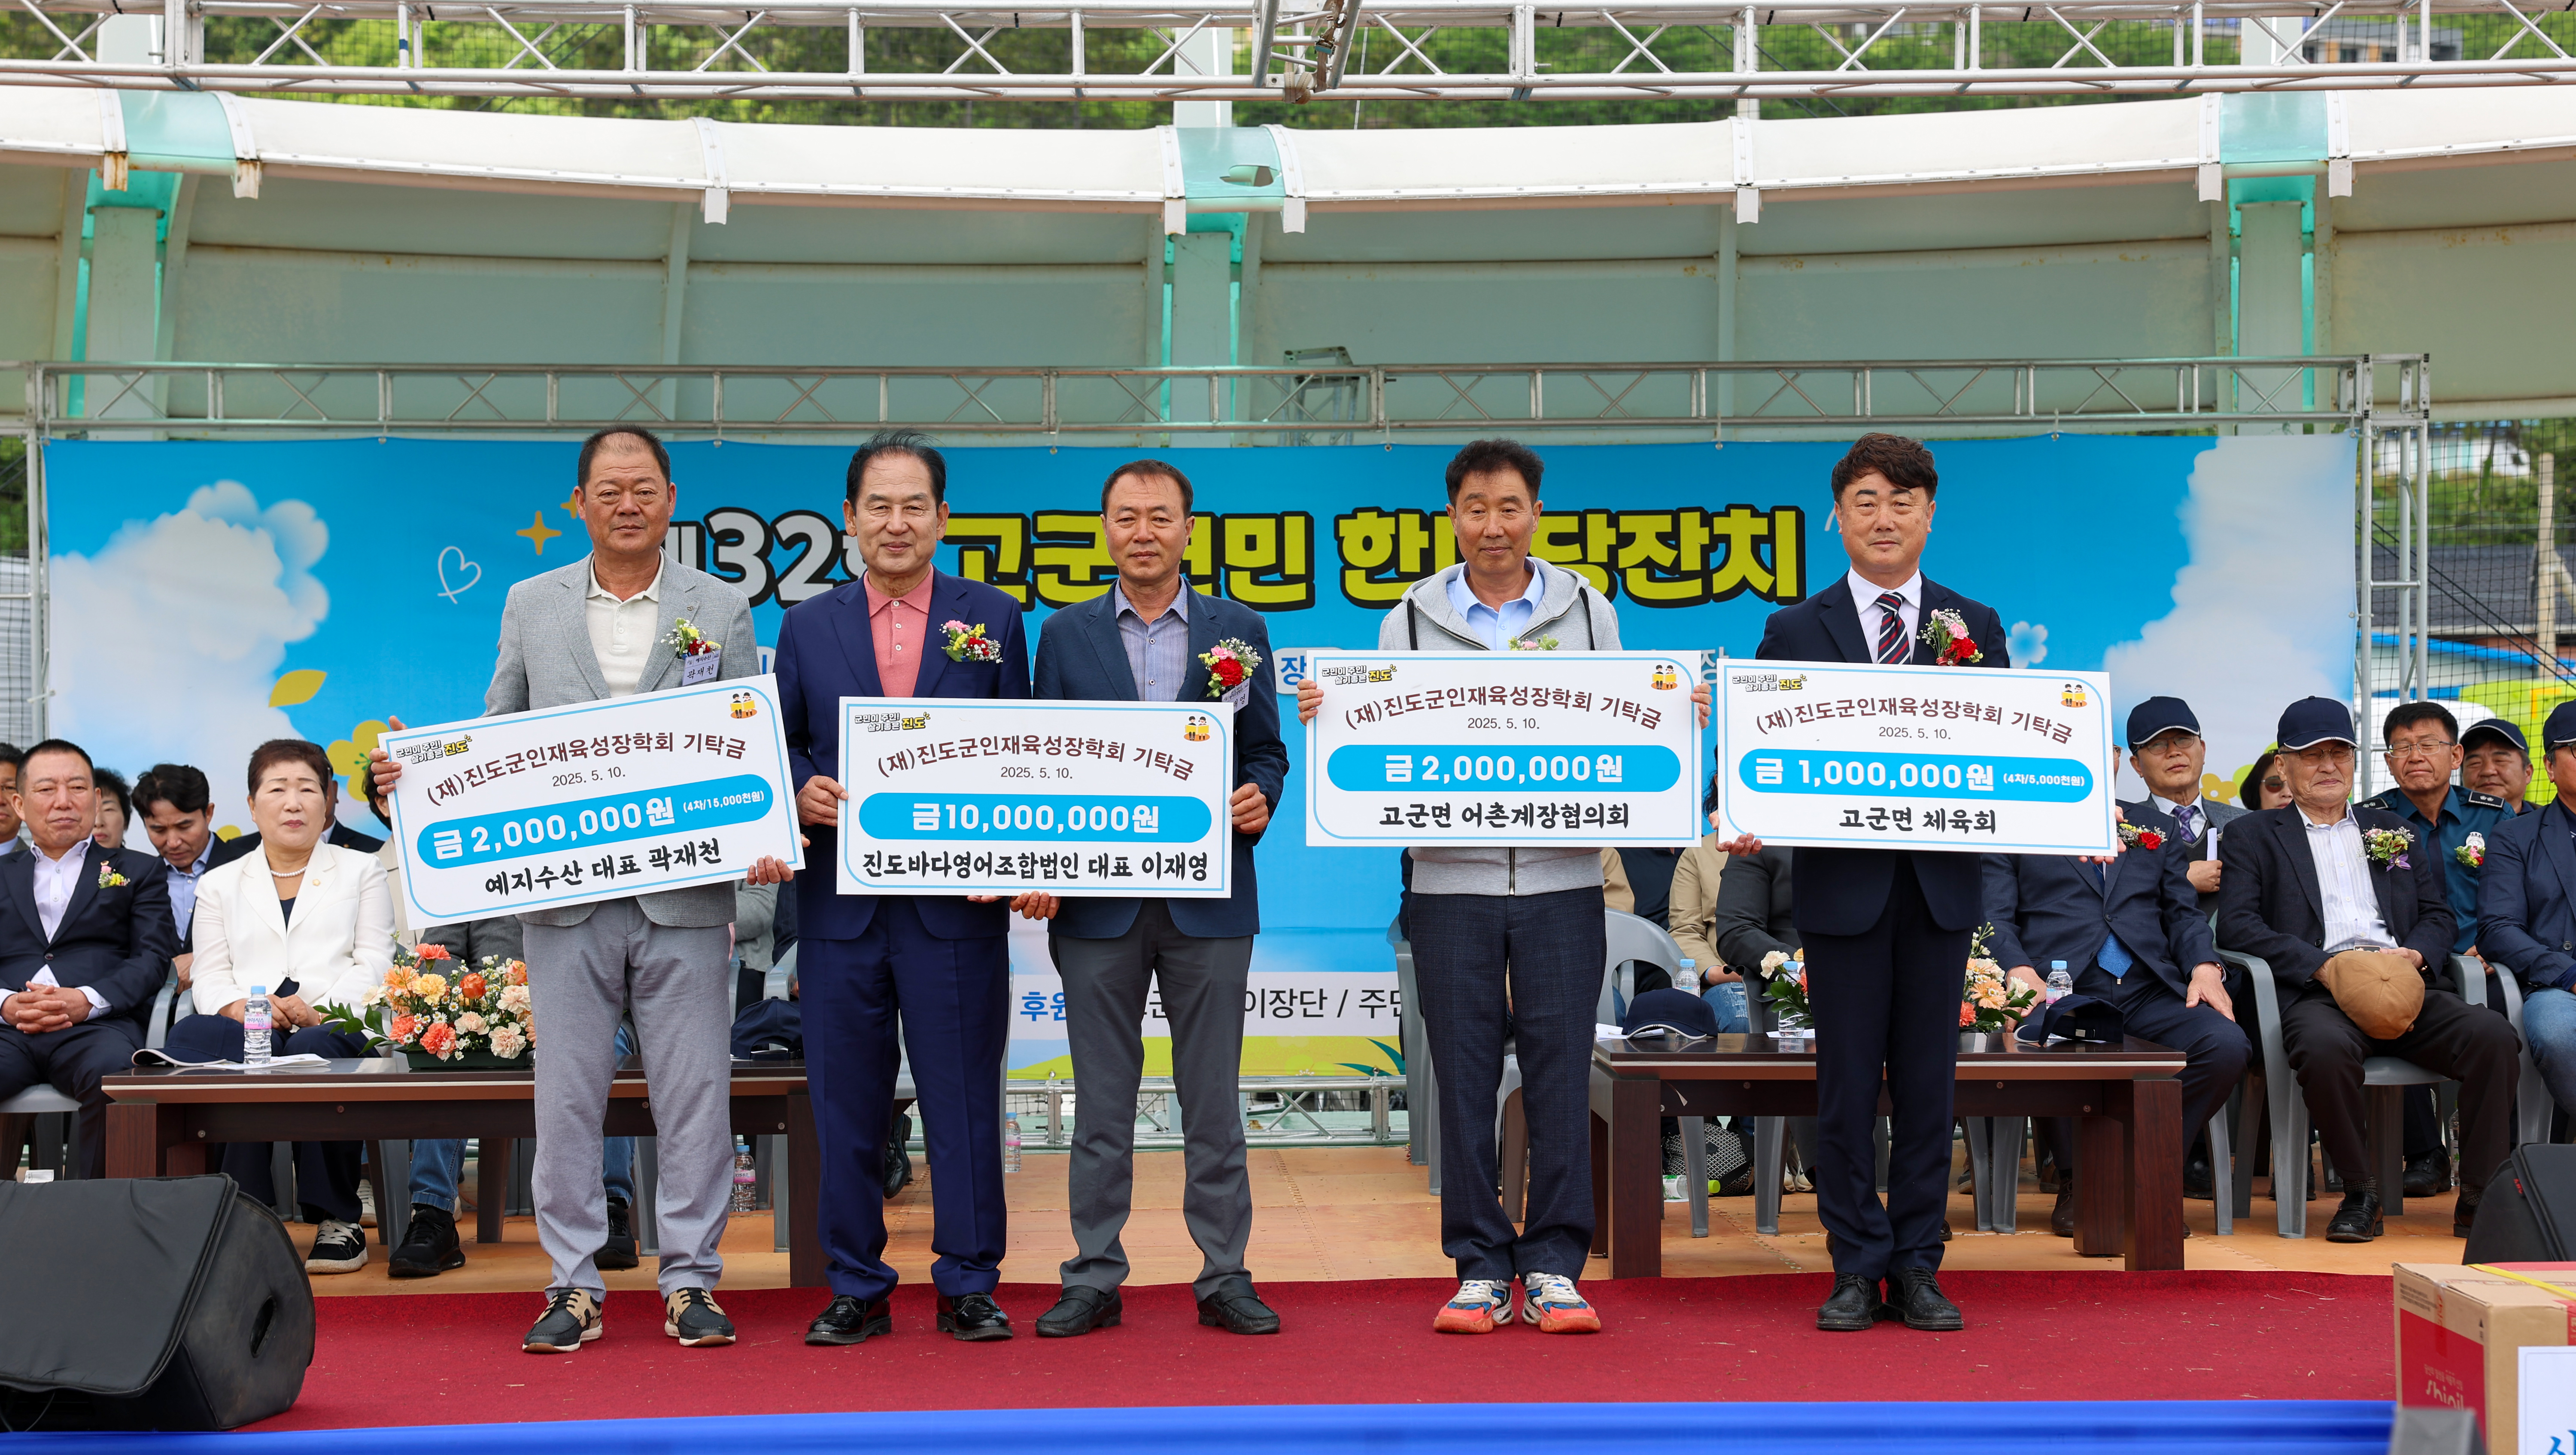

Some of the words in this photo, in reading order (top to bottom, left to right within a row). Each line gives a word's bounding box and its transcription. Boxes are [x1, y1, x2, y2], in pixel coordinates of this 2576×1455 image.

[1337, 505, 1803, 605] 한당잔치
[1322, 667, 1346, 676] 군민이
[1348, 665, 1367, 675] 주인!
[1335, 674, 1367, 685] 살기좋은
[1368, 670, 1392, 682] 진도
[1732, 675, 1756, 684] 군민이
[1758, 674, 1777, 683] 주인!
[1745, 683, 1777, 692] 살기좋은
[1779, 679, 1802, 690] 진도
[855, 714, 879, 723] 군민이
[881, 712, 900, 722] 주인!
[1345, 686, 1592, 731] (재)진도군인재육성장학회
[1600, 697, 1662, 731] 기탁금
[868, 722, 900, 732] 살기좋은
[902, 717, 926, 730] 진도
[1467, 718, 1501, 730] 2025.
[1506, 718, 1517, 730] 5.
[1523, 718, 1540, 730] 10.
[1756, 697, 2002, 734] (재)진도군인재육성장학회
[2011, 711, 2072, 745] 기탁금
[1878, 726, 1913, 739] 2025.
[1917, 728, 1929, 740] 5.
[1934, 728, 1951, 740] 10.
[396, 745, 420, 758] 군민이
[422, 740, 441, 751] 주인!
[411, 749, 443, 764] 살기좋은
[444, 740, 468, 756] 진도
[878, 735, 1126, 777] (재)진도군인재육성장학회
[1133, 748, 1194, 782] 기탁금
[427, 732, 673, 807] (재)진도군인재육성장학회
[683, 733, 746, 760] 기탁금
[552, 772, 587, 787] 2025.
[592, 770, 603, 781] 5.
[608, 766, 626, 779] 10.
[1000, 767, 1034, 779] 2025.
[1039, 767, 1051, 779] 5.
[1056, 767, 1073, 779] 10.
[2003, 772, 2085, 787] (4차/5,000천원)
[683, 790, 765, 813] (4차/15,000천원)
[912, 803, 1159, 834] 금10,000,000원
[1379, 802, 1452, 828] 고군면
[1461, 801, 1629, 829] 어촌계장협의회
[1839, 807, 1914, 831] 고군면
[1922, 807, 1996, 835] 체육회
[485, 860, 583, 896] 예지수산
[591, 854, 642, 880] 대표
[648, 837, 722, 872] 곽재천
[862, 850, 1078, 880] 진도바다영어조합법인
[1088, 852, 1133, 880] 대표
[1141, 851, 1208, 882] 이재영
